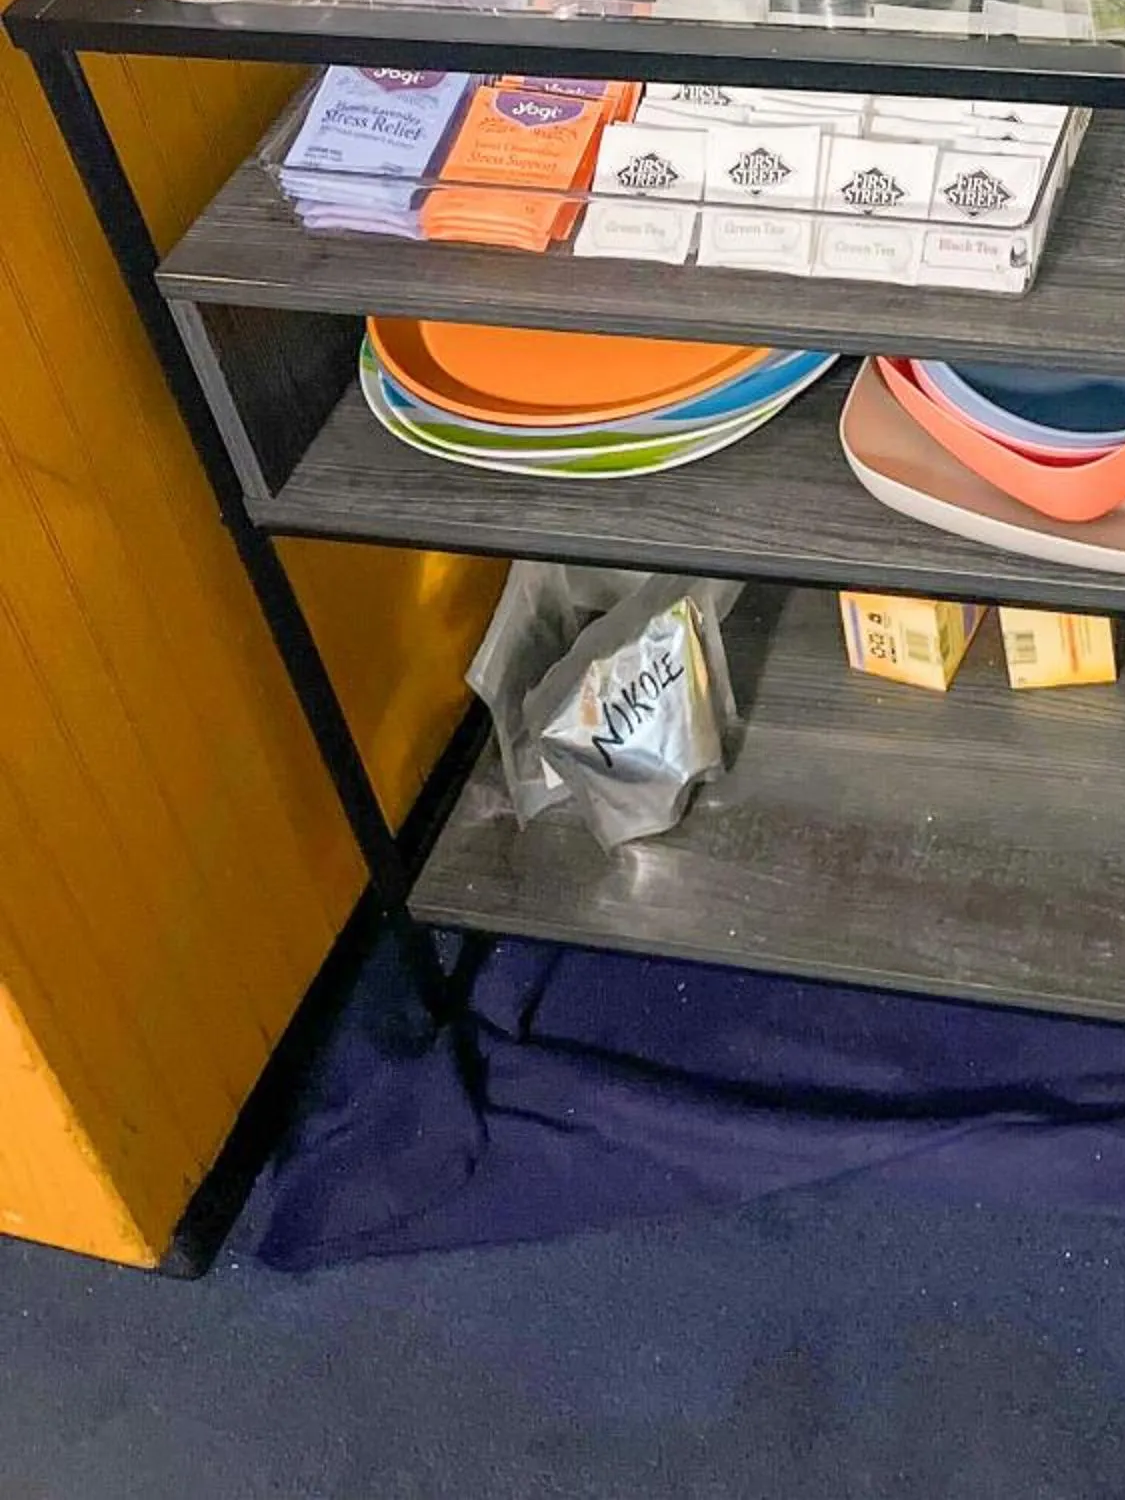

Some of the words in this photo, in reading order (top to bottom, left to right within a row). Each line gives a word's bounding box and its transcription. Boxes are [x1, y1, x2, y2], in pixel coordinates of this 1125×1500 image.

[512, 101, 560, 120] yogi
[321, 109, 367, 128] Stress
[371, 115, 422, 140] Relief
[629, 156, 671, 174] FIRST
[739, 152, 781, 170] FIRST
[619, 171, 676, 188] STREET
[732, 168, 789, 186] STREET
[853, 172, 894, 190] FIRST
[957, 173, 1000, 192] FIRST
[844, 188, 903, 206] STREET
[949, 190, 1007, 209] STREET
[591, 651, 685, 768] NIKOLE
